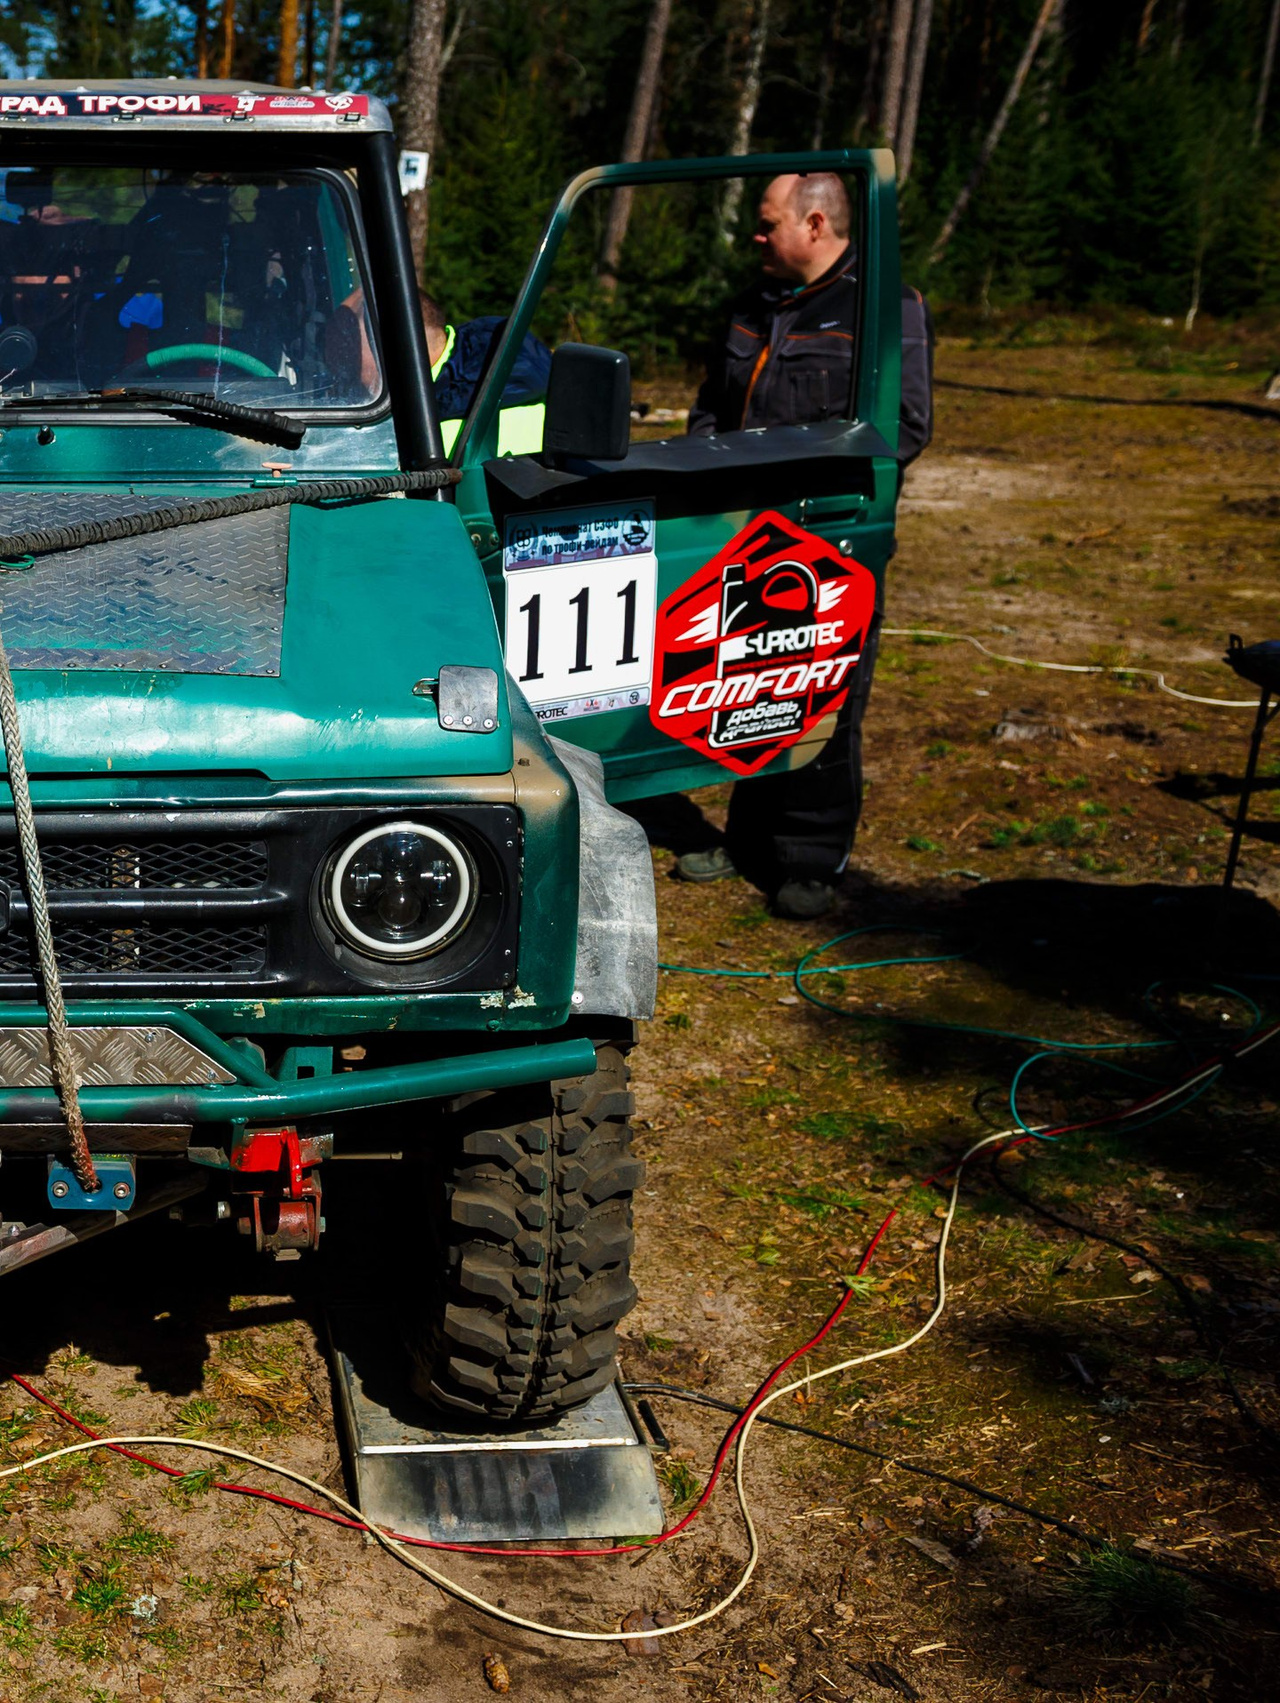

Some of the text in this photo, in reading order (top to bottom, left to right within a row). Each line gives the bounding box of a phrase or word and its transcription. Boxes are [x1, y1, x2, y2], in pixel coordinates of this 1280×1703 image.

[78, 94, 202, 113] ТРОФИ
[518, 579, 641, 683] 111
[740, 620, 845, 657] SUPROTEC
[658, 654, 861, 718] COMFORT
